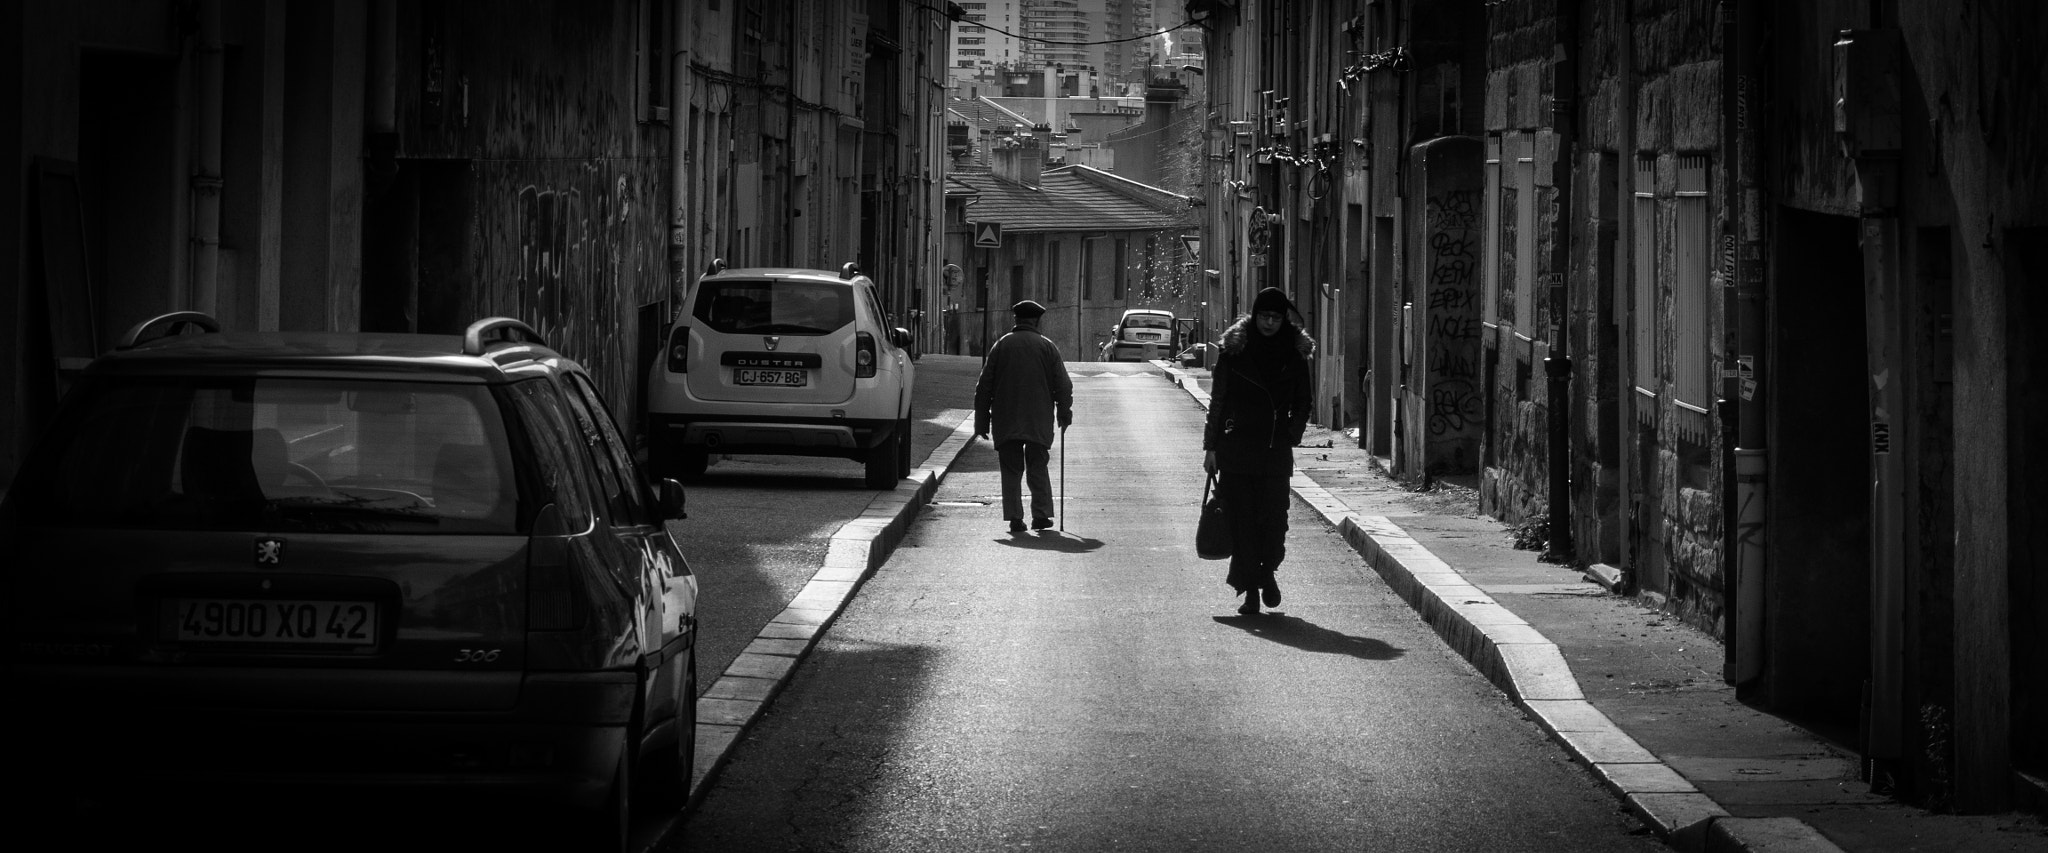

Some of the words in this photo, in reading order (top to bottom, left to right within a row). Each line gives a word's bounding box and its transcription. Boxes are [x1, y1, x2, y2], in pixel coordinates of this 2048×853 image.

[1725, 236, 1734, 287] COLT/PITR
[738, 359, 803, 367] DUSTER
[1875, 424, 1889, 453] KNX
[183, 602, 267, 637] 4900
[276, 604, 317, 638] XQ
[326, 605, 367, 639] 42
[19, 641, 113, 656] PEUGEOT
[454, 649, 502, 662] 306
